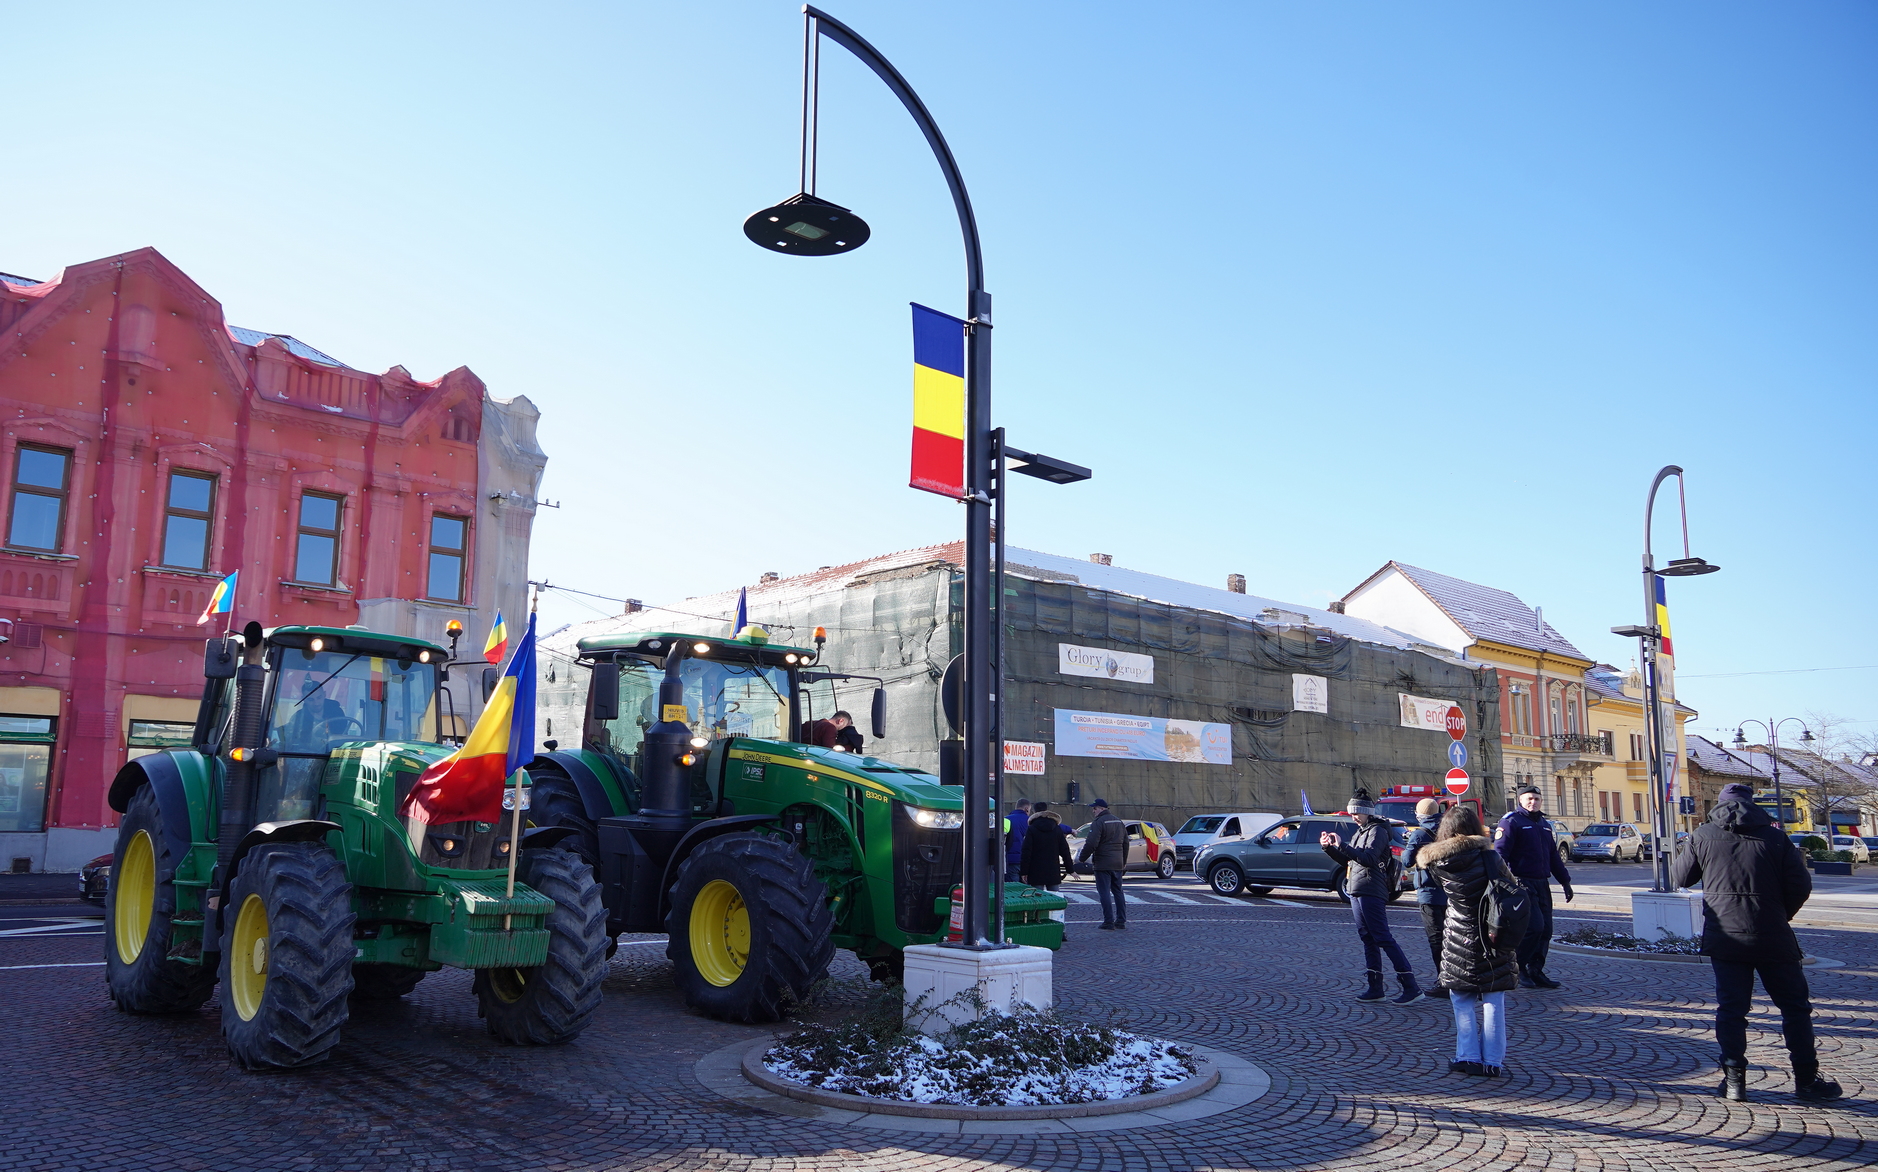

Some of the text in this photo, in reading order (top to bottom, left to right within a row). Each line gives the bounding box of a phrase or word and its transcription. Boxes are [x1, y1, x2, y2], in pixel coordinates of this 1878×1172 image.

[1067, 647, 1102, 671] Glory
[1118, 666, 1142, 677] grup
[1095, 717, 1113, 725] TUNISIA
[1446, 716, 1466, 730] STOP
[1010, 744, 1043, 757] MAGAZIN
[742, 752, 772, 763] JOHN DEERE
[1004, 758, 1044, 772] ALIMENTAR
[866, 791, 882, 800] 8320
